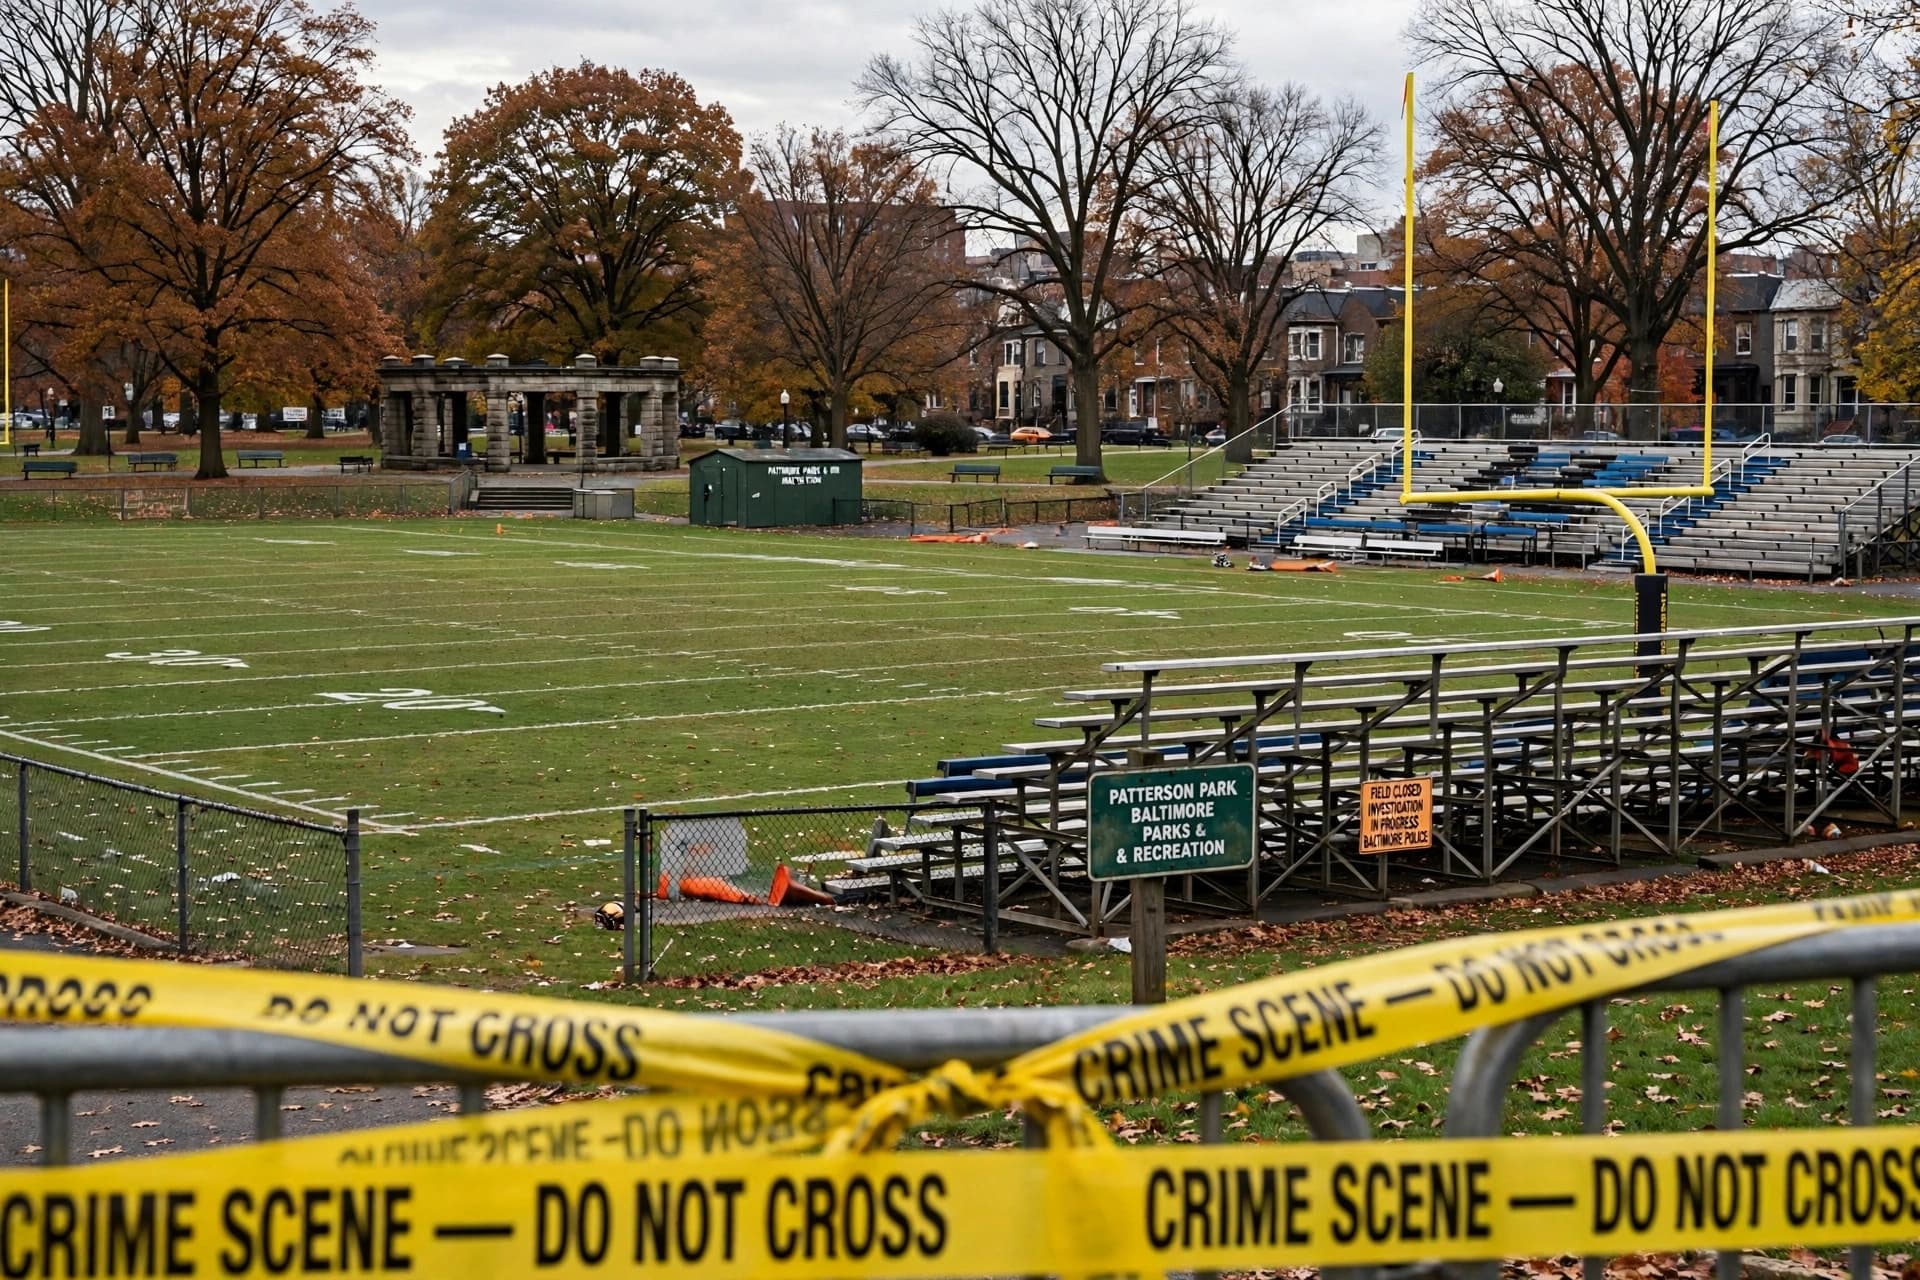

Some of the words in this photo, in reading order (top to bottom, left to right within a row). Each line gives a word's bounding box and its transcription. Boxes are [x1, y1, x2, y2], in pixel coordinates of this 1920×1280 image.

[1109, 783, 1195, 805] PATTERSON
[1199, 780, 1238, 798] PARK
[1371, 785, 1391, 799] FIELD
[1393, 783, 1422, 798] CLOSED
[1131, 802, 1215, 824] BALTIMORE
[1371, 818, 1379, 831] IN
[1143, 822, 1191, 842] PARKS
[1195, 823, 1207, 837] &
[1404, 830, 1428, 844] POLICE
[1116, 848, 1127, 864] &
[1133, 839, 1225, 863] RECREATION
[348, 1003, 456, 1043] NOT
[1073, 1017, 1223, 1103] CRIME
[1229, 981, 1376, 1070] SCENE
[1146, 1166, 1310, 1251] CRIME
[1330, 1160, 1492, 1244] SCENE
[1592, 1155, 1657, 1235] DO
[1674, 1151, 1767, 1232] NOT
[1, 1190, 195, 1280] CRIME
[219, 1186, 413, 1276] SCENE
[535, 1181, 611, 1267] DO
[633, 1177, 746, 1265] NOT
[766, 1172, 948, 1262] CROSS
